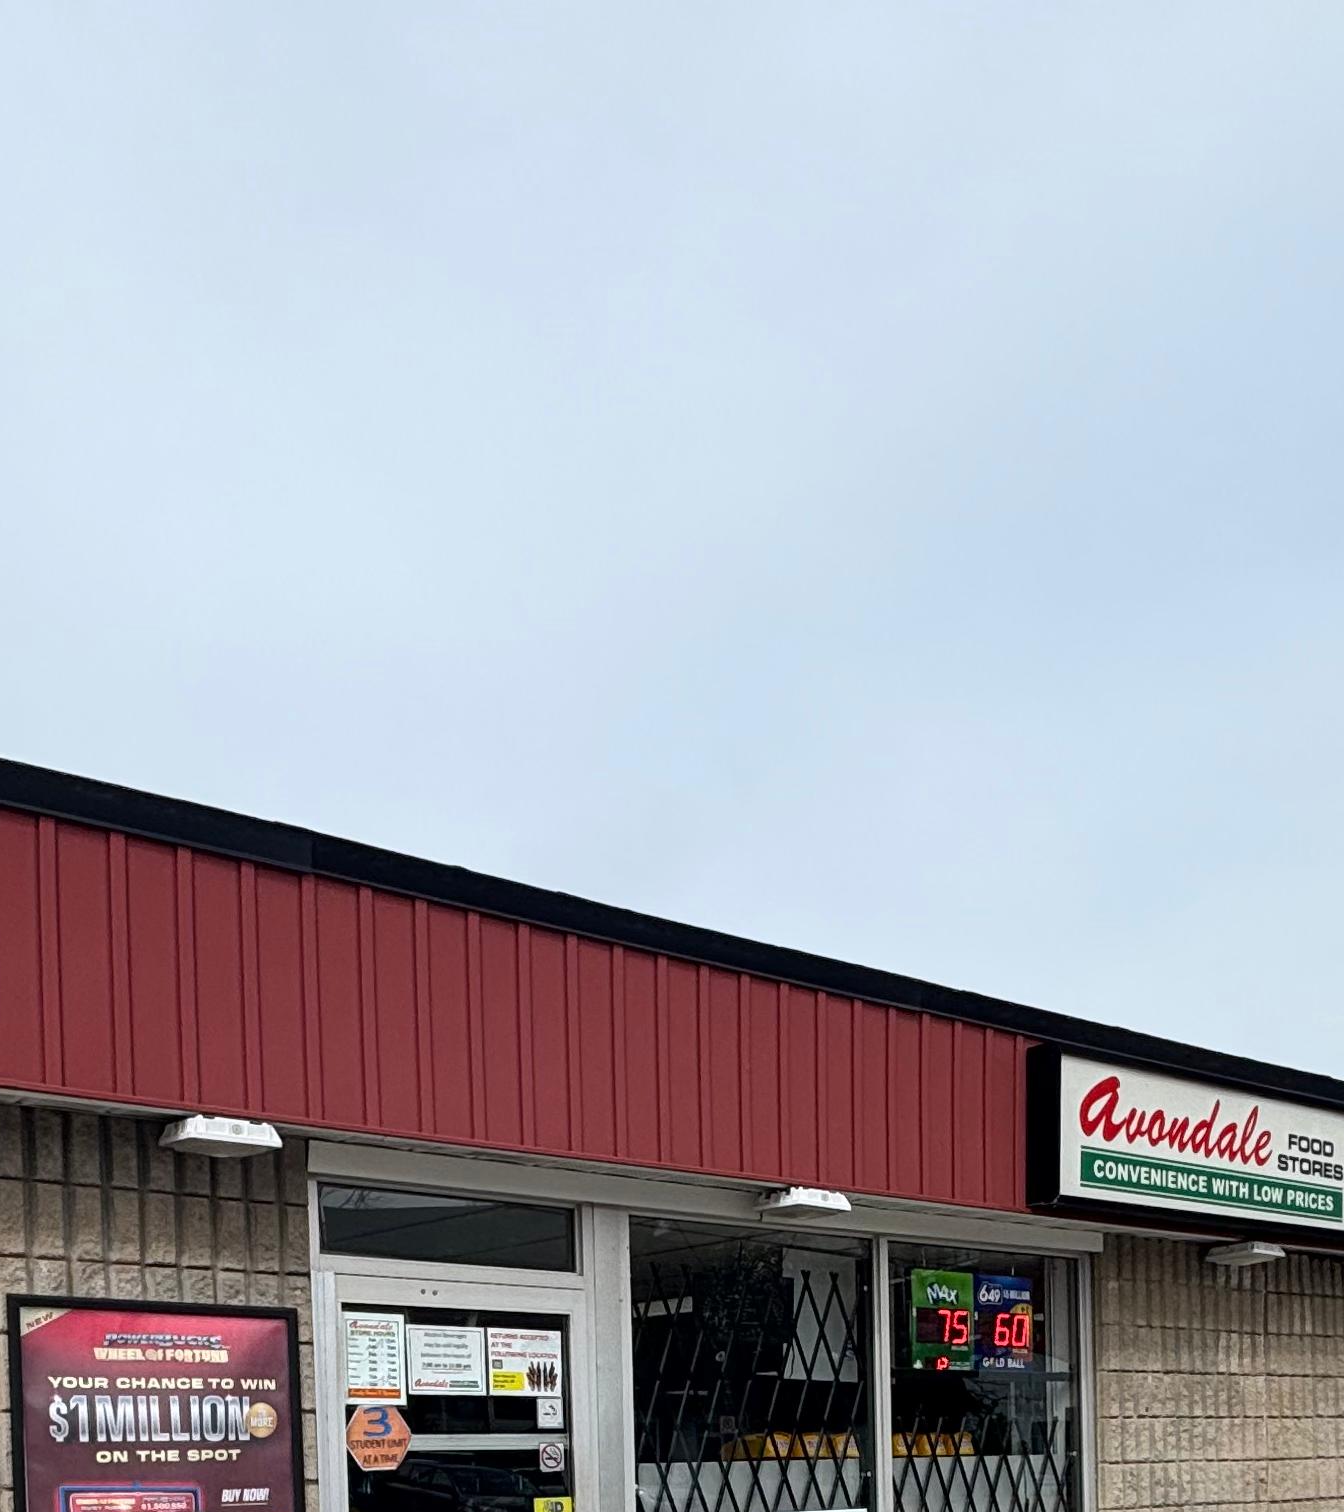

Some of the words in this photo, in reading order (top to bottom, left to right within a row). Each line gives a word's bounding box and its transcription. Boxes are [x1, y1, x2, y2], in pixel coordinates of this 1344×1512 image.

[1080, 1076, 1272, 1166] Avondale
[1288, 1134, 1334, 1157] FOOD
[1278, 1154, 1344, 1181] STORES
[1094, 1159, 1207, 1193] CONVENIENCE
[1212, 1177, 1249, 1200] WITH
[1254, 1184, 1283, 1204] LOW
[1287, 1189, 1334, 1211] PRICES
[927, 1283, 958, 1305] MAX
[26, 1311, 54, 1330] NEW
[938, 1309, 968, 1344] 75
[994, 1313, 1030, 1347] 60
[94, 1347, 145, 1361] WHEEL
[165, 1348, 229, 1363] FORTUNE
[1007, 1358, 1025, 1369] BALL
[47, 1375, 109, 1390] YOUR
[116, 1376, 203, 1391] CHANCE
[208, 1378, 234, 1391] TO
[241, 1378, 276, 1391] WIN
[250, 1415, 274, 1428] MORE
[363, 1406, 392, 1437] 3
[350, 1438, 386, 1450] STUDENT
[96, 1450, 128, 1464] ON
[136, 1450, 180, 1463] THE
[187, 1449, 241, 1463] SPOT
[362, 1454, 372, 1465] AT
[221, 1488, 242, 1502] BUY
[242, 1487, 270, 1501] NOW!
